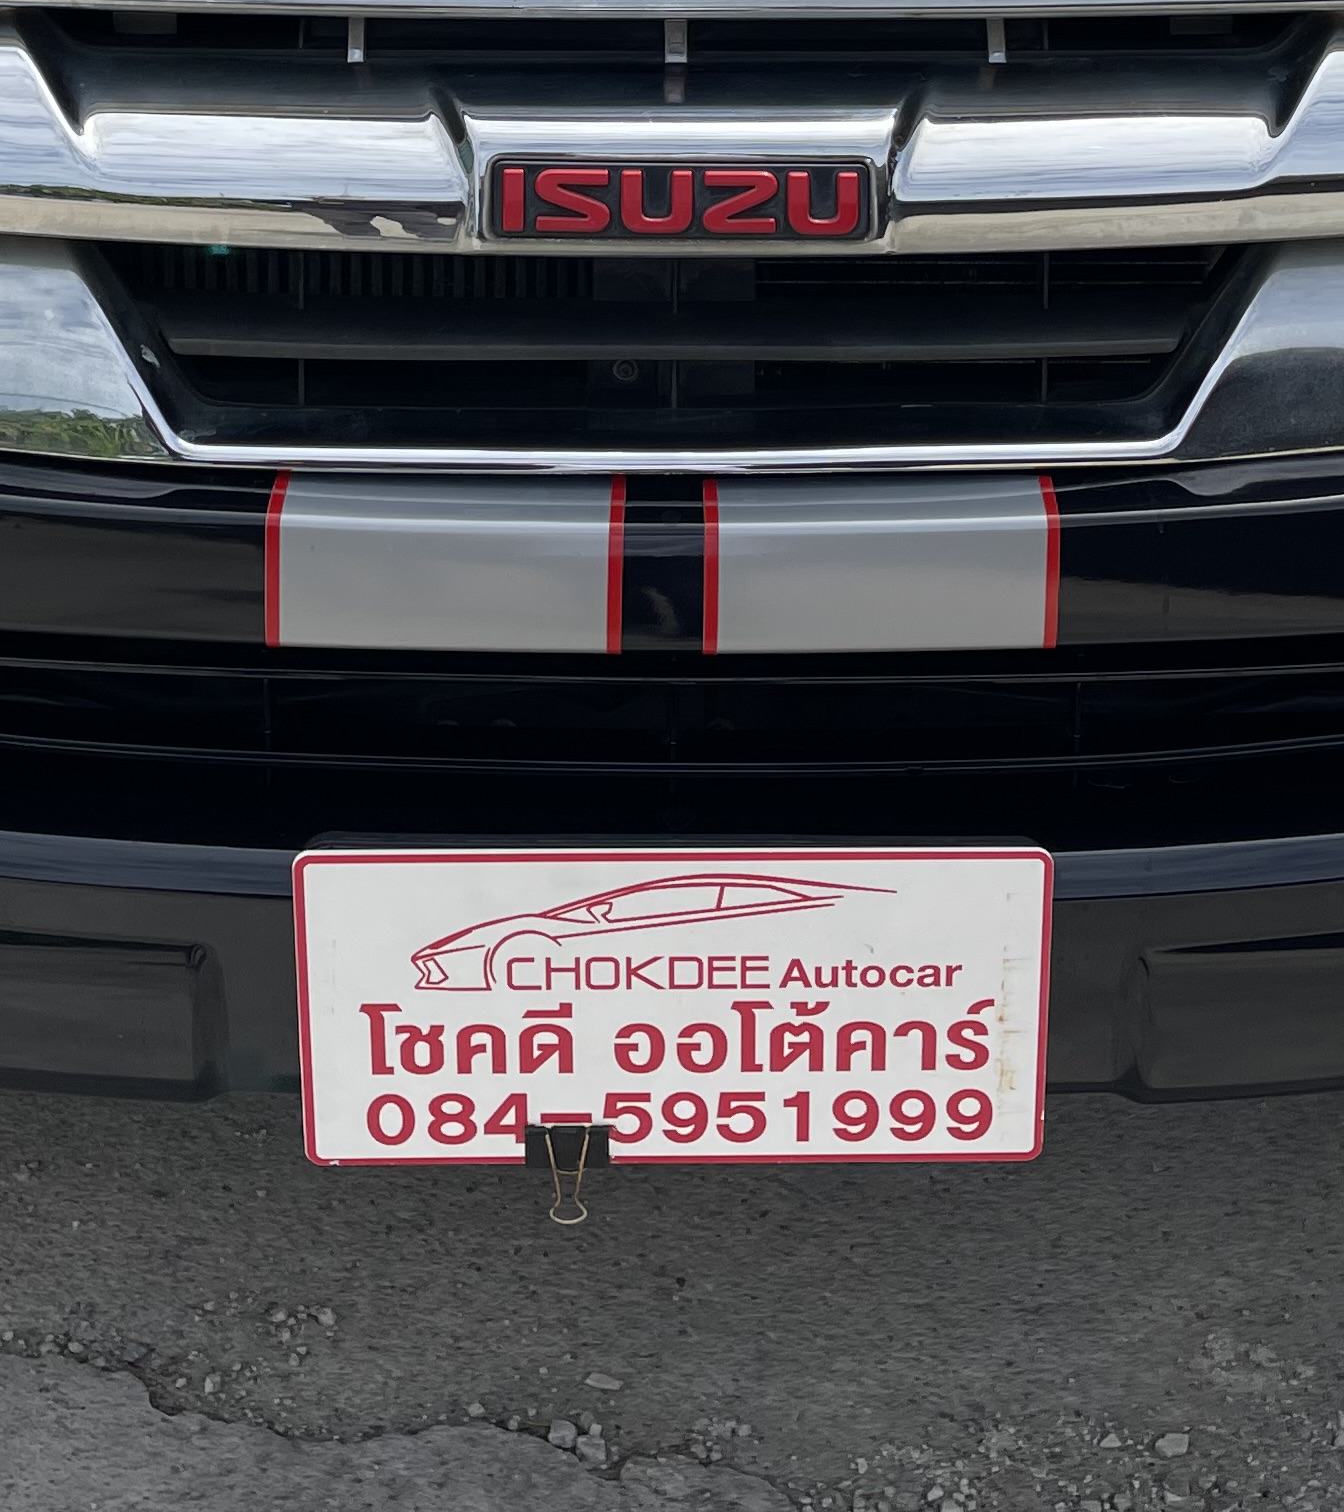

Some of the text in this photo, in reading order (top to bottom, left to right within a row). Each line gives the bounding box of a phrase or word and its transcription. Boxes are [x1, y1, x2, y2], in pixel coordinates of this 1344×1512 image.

[502, 168, 859, 235] ISUZU
[506, 955, 963, 991] CHOKDEE Autocar
[360, 999, 996, 1076] โชคดี ออโต้คาร์
[366, 1089, 994, 1146] 084-5951999
